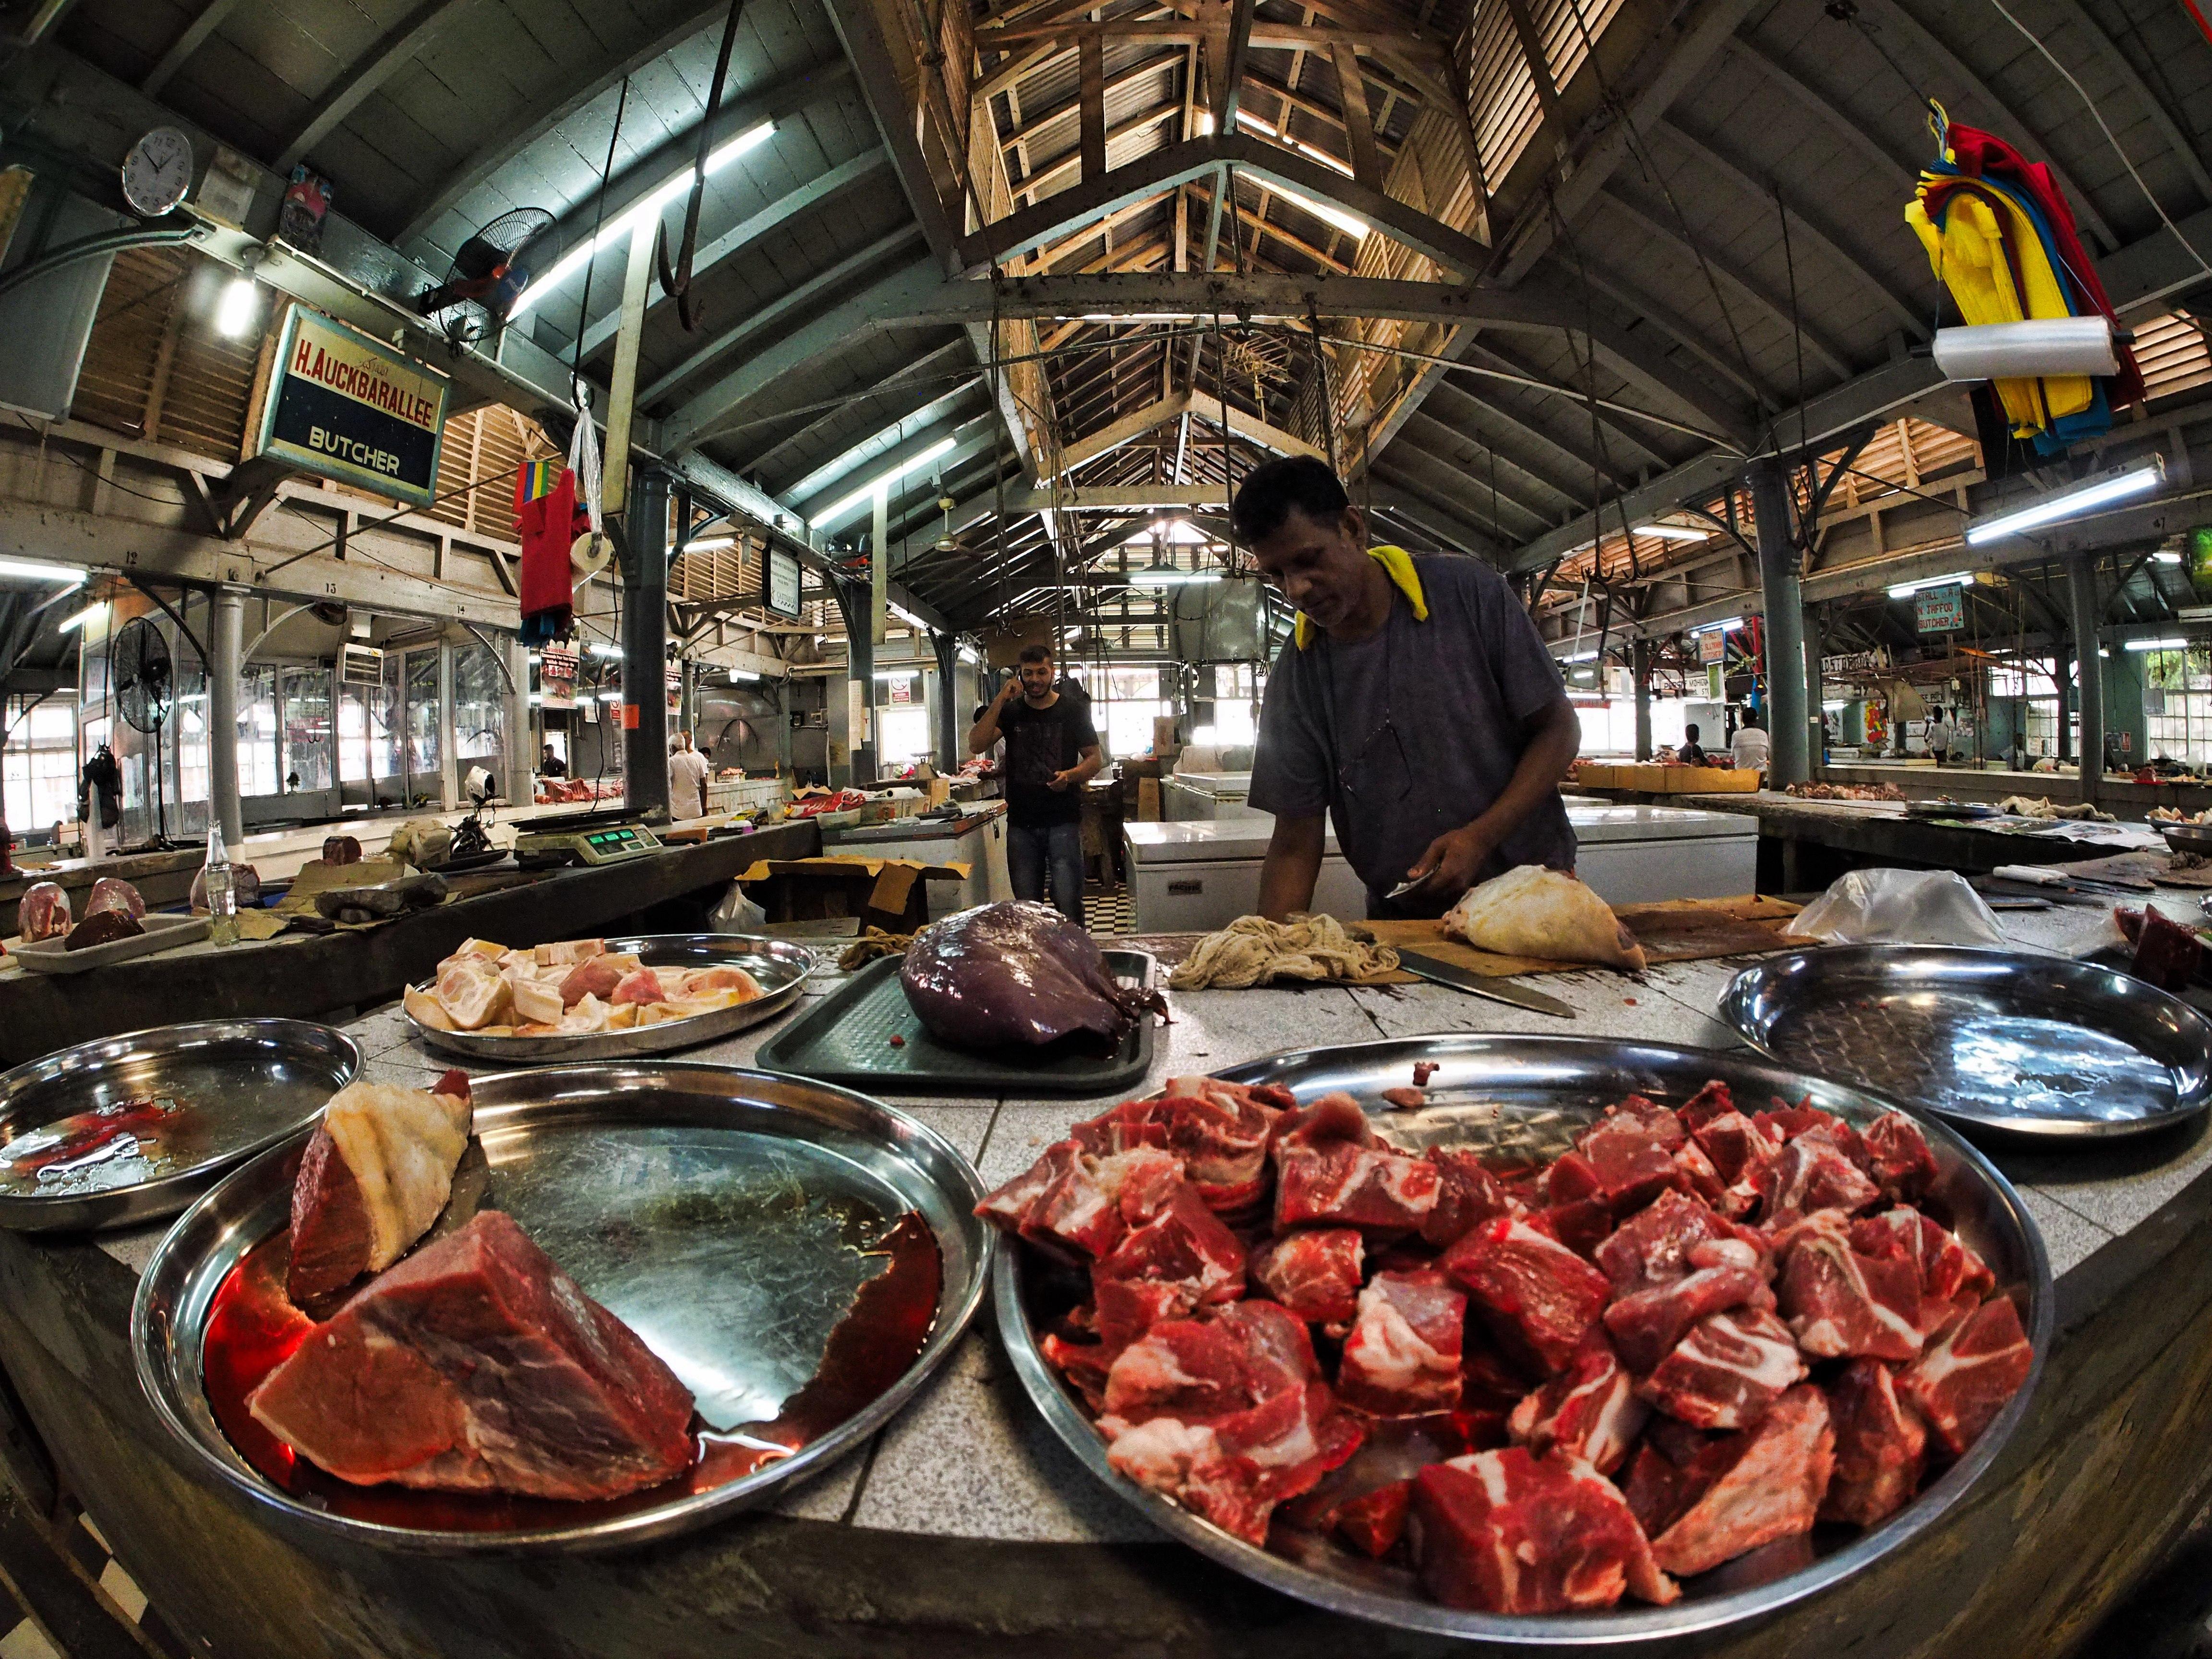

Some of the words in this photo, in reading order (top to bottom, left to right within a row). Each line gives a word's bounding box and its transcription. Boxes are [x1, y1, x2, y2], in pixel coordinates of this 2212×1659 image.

[295, 339, 433, 428] H.AUCKBARALLEE
[309, 425, 400, 476] BUTCHER
[126, 550, 138, 565] 12
[326, 583, 337, 594] 13
[1917, 590, 1939, 602] STALL
[457, 605, 465, 615] 14
[1918, 616, 1950, 629] BUTCHER
